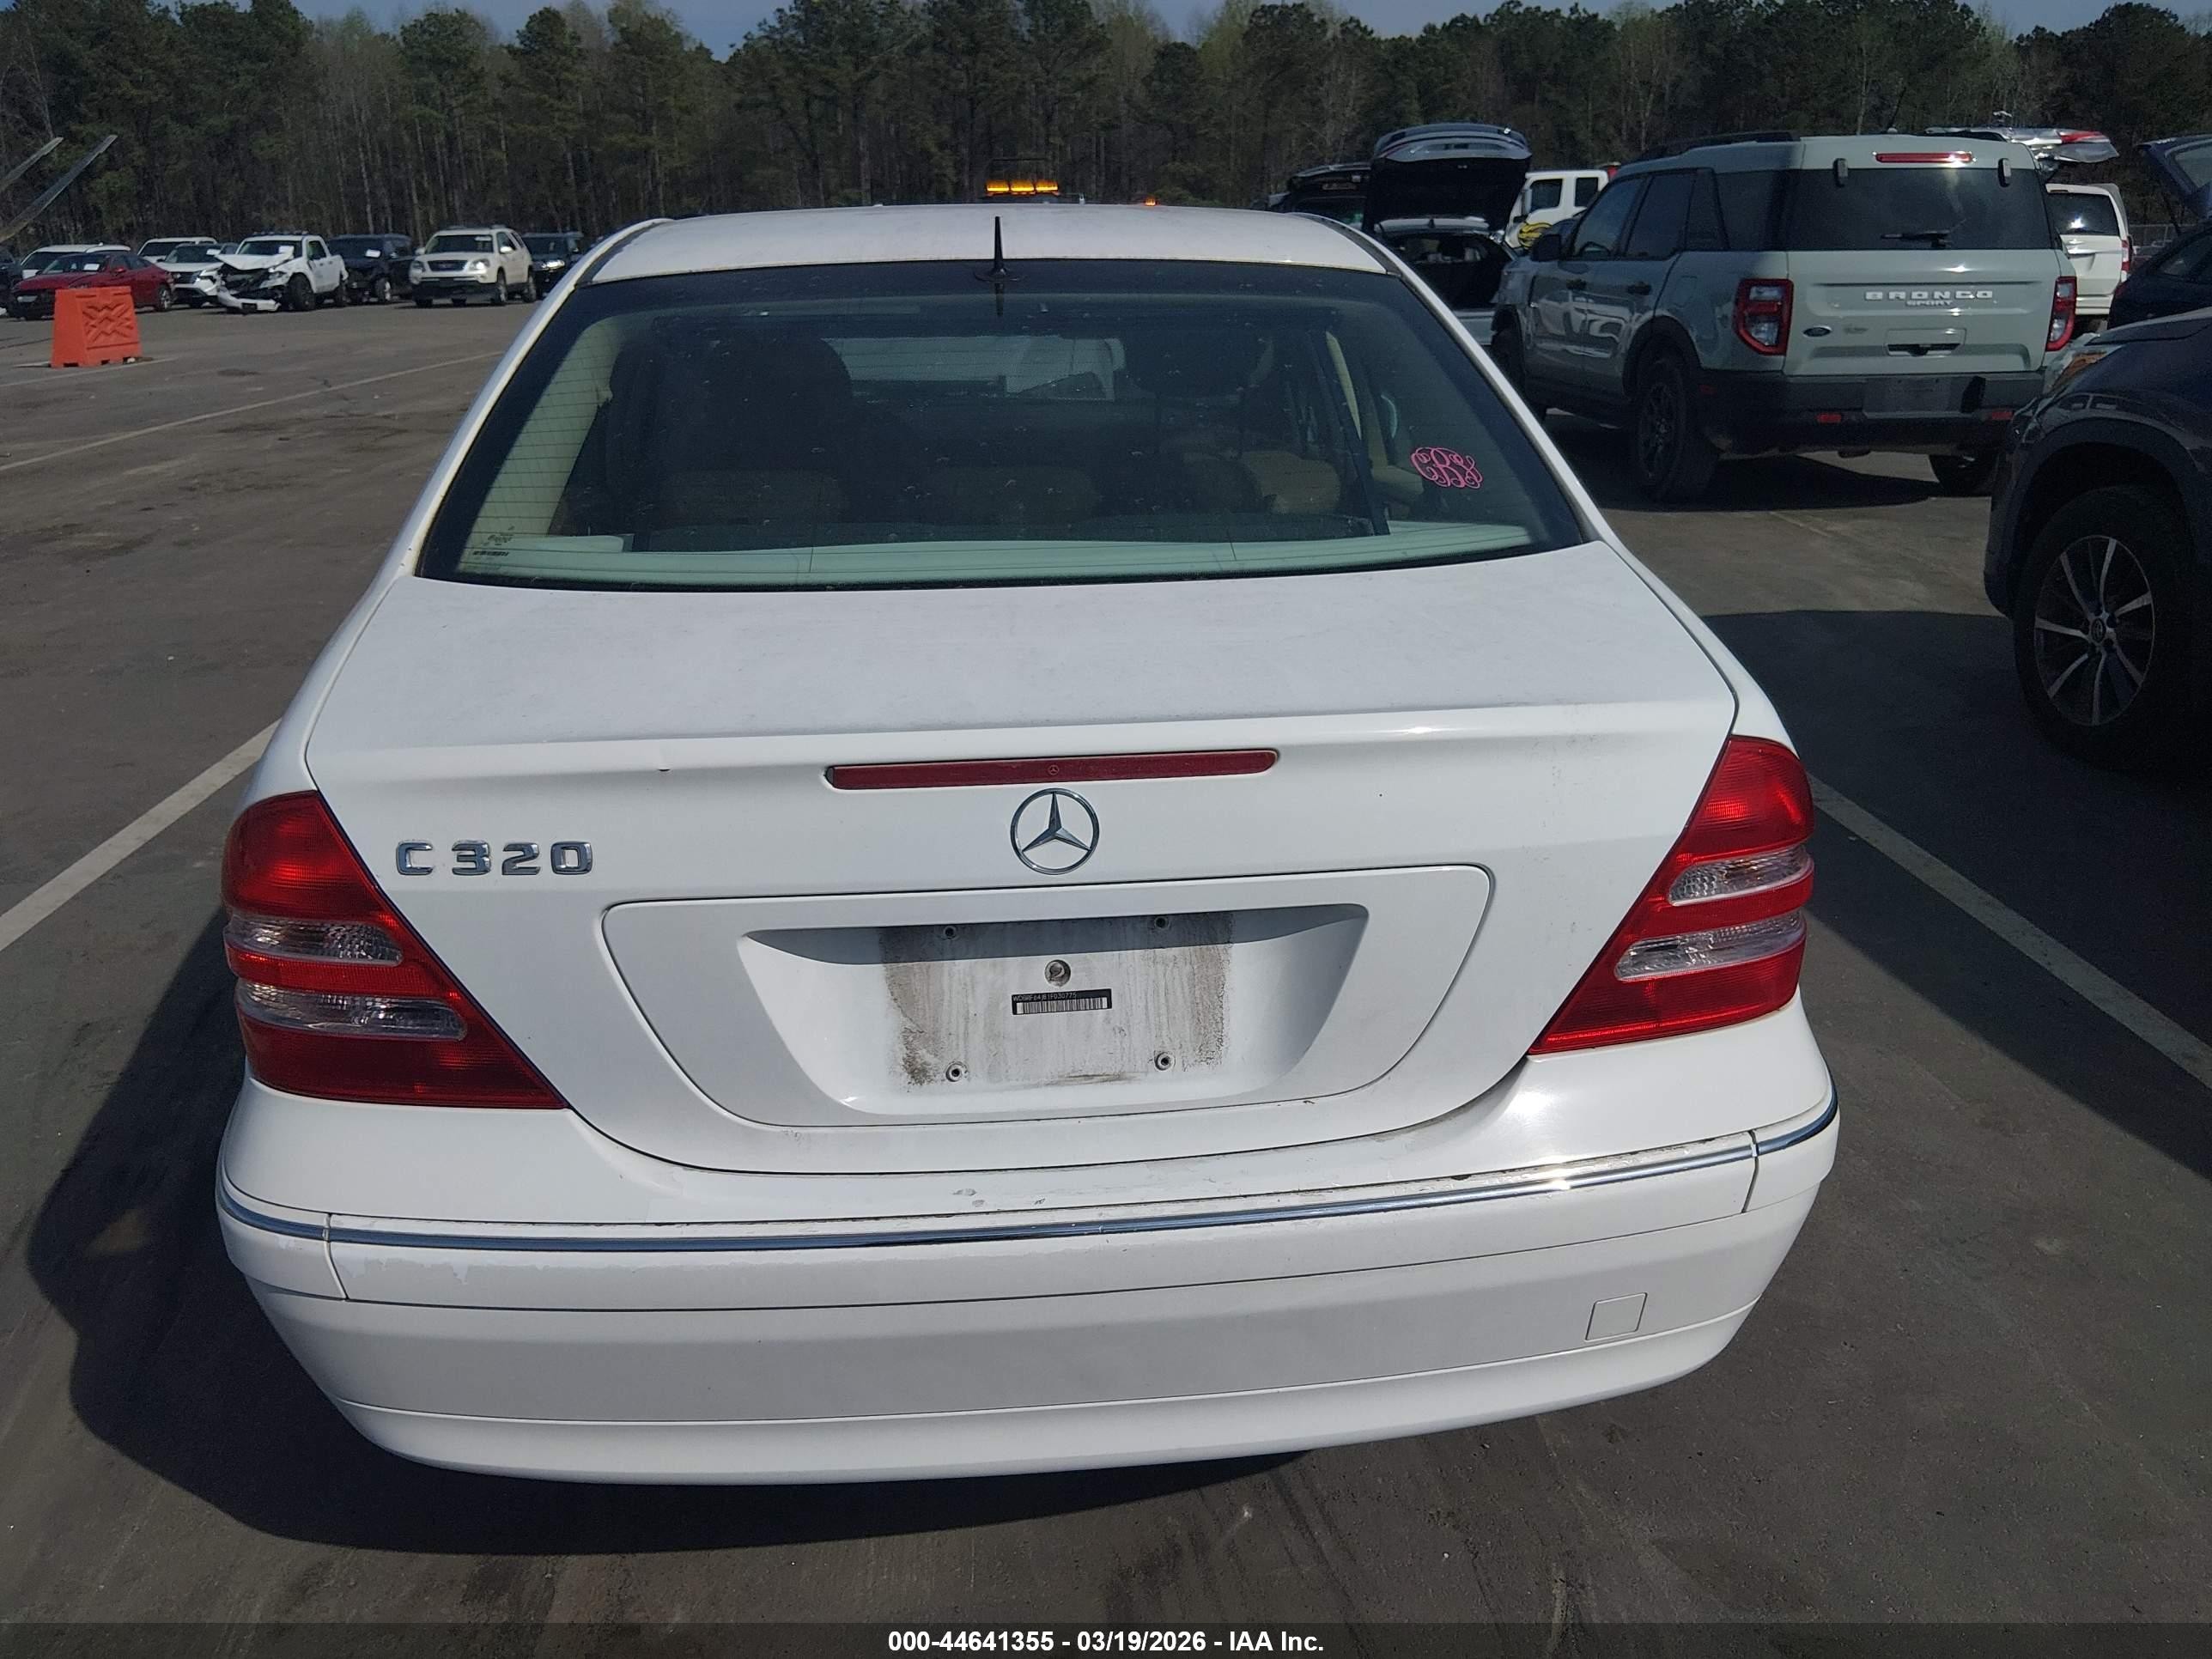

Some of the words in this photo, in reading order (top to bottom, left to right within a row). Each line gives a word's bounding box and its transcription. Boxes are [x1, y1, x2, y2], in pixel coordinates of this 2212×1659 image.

[1865, 290, 1993, 301] BRONCO
[395, 841, 434, 876] C
[451, 840, 593, 876] 320
